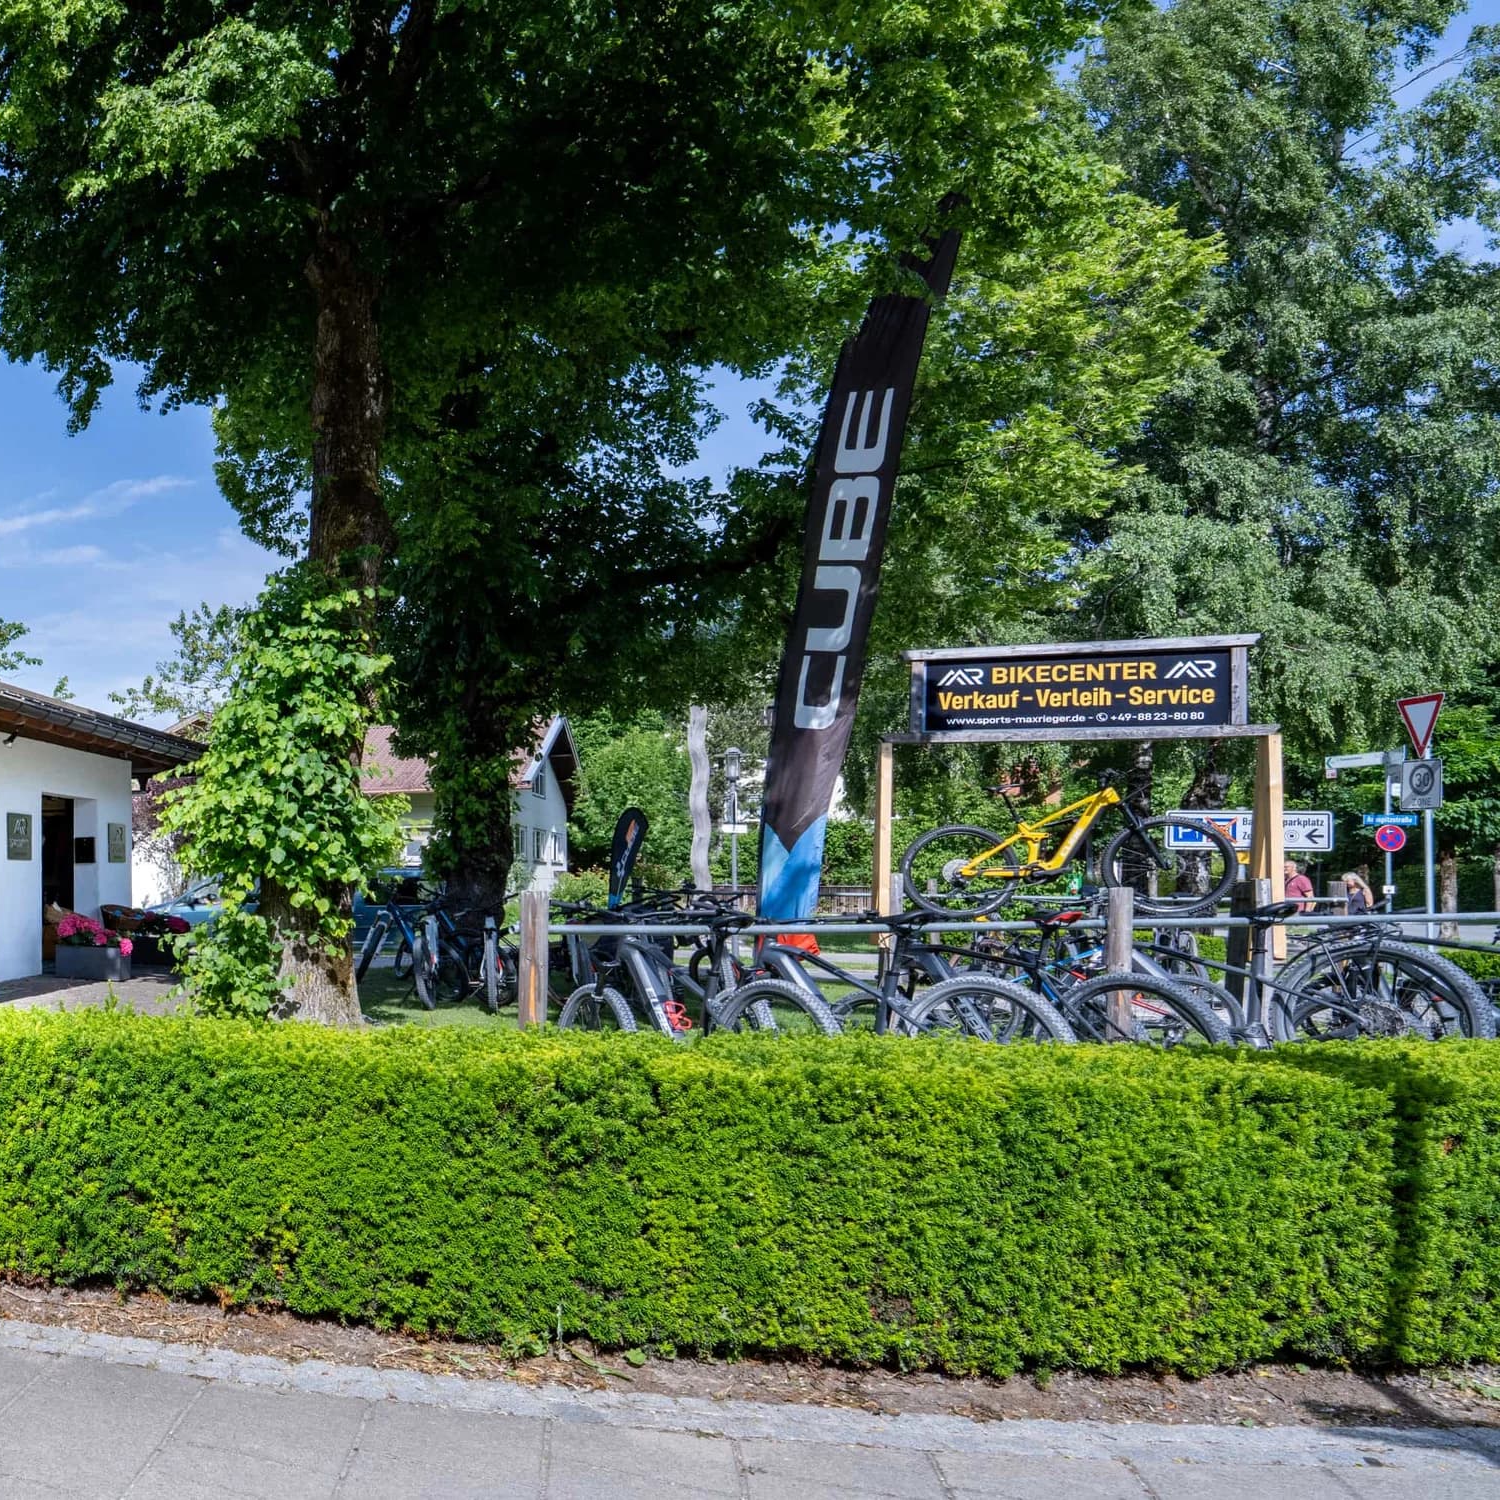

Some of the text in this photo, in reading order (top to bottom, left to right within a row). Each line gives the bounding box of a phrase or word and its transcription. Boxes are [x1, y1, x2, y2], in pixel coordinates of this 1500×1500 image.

[793, 387, 895, 731] CUBE
[991, 662, 1157, 685] BIKECENTER
[938, 690, 1020, 711] Verkauf
[1035, 687, 1112, 708] Verleih
[1128, 685, 1216, 706] Service
[946, 714, 1086, 726] www.sports-maxrieger.de
[1415, 772, 1430, 788] 30
